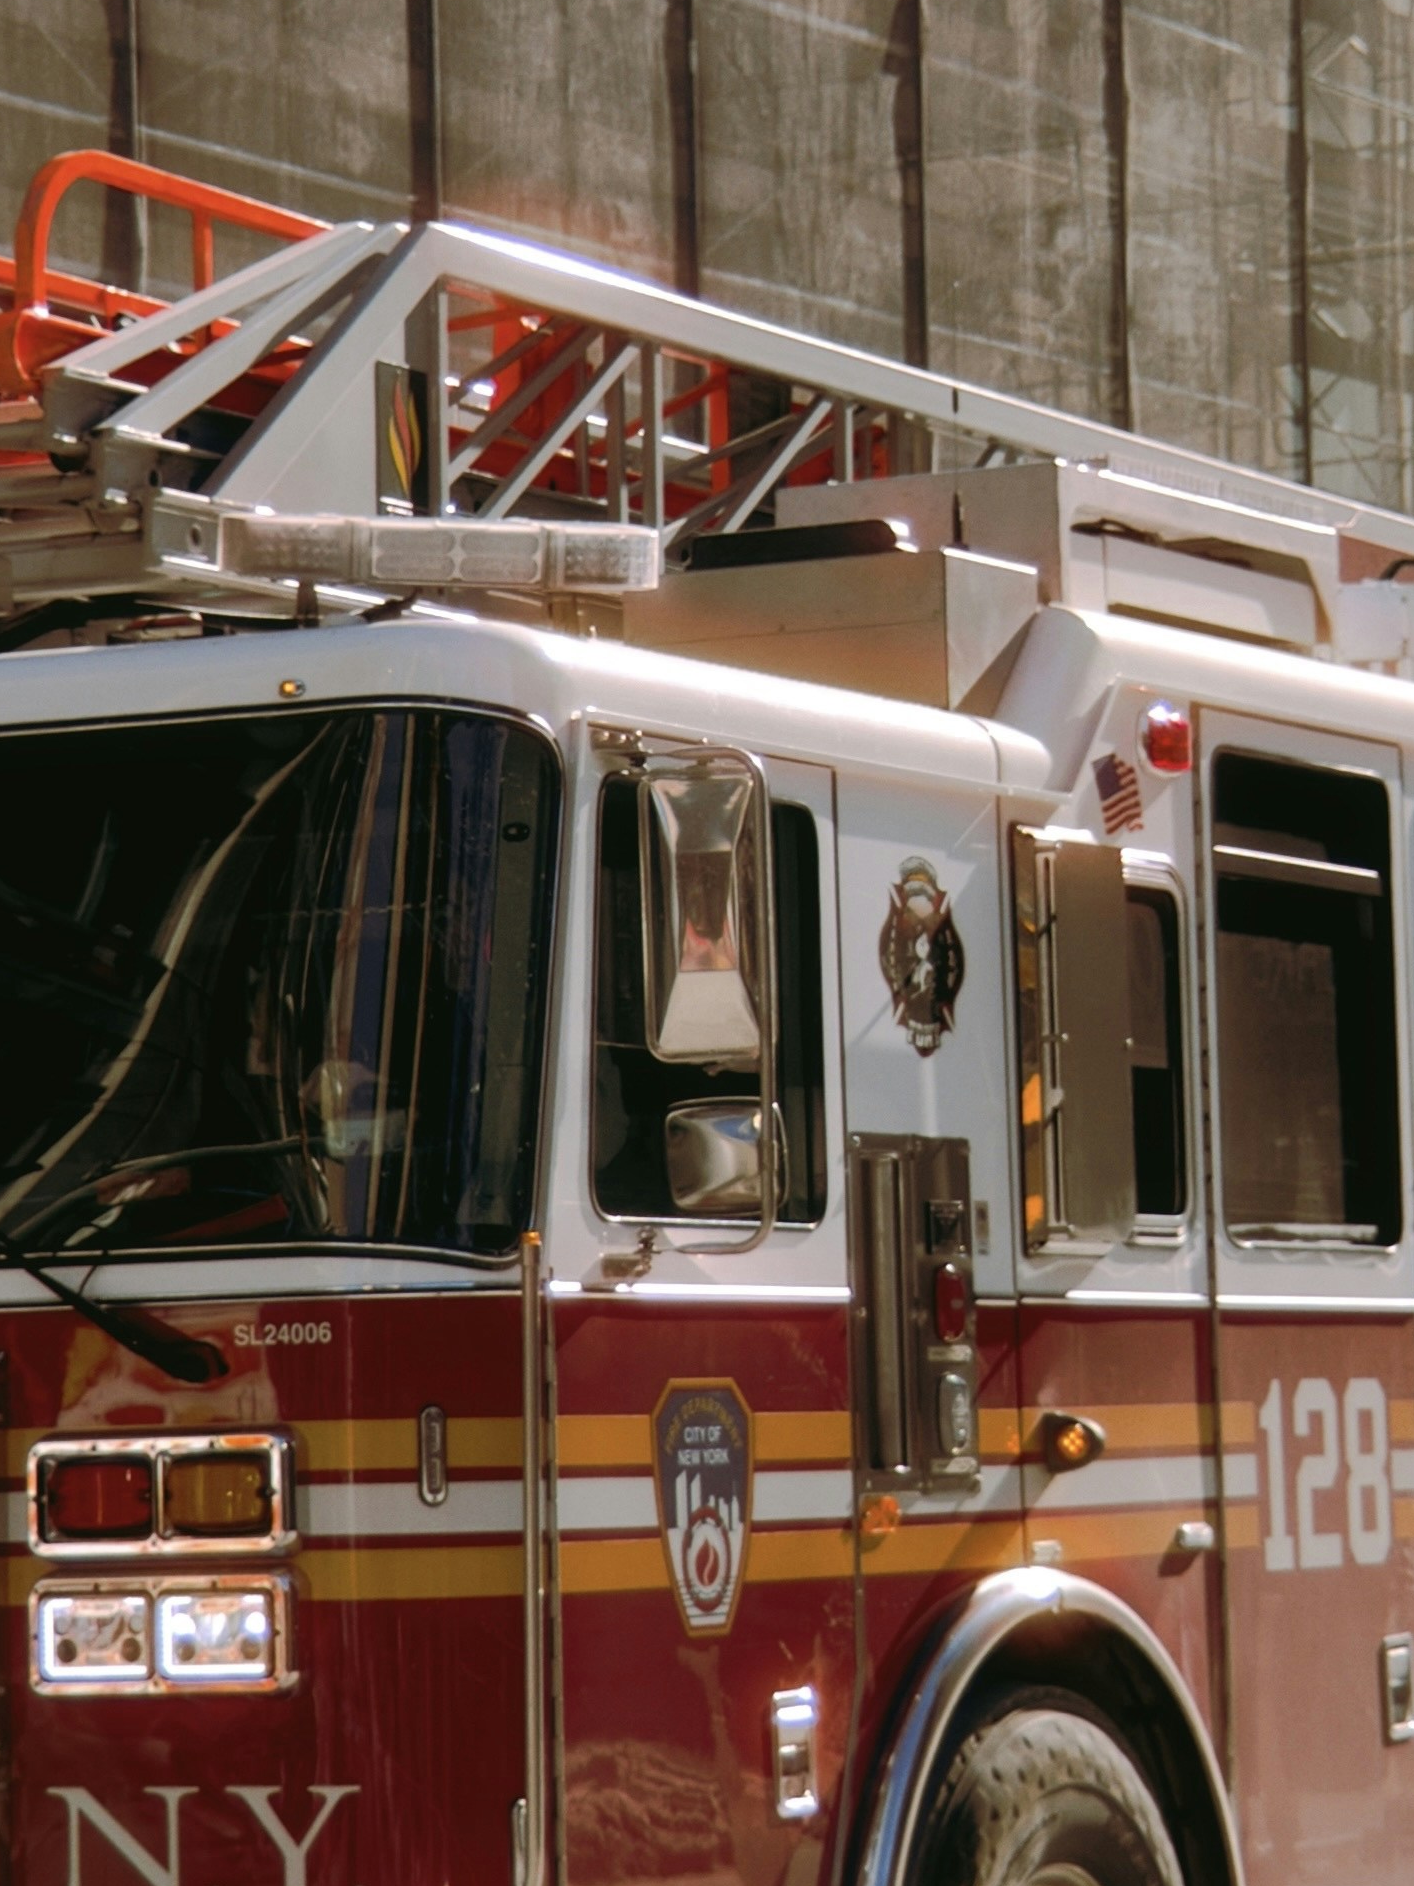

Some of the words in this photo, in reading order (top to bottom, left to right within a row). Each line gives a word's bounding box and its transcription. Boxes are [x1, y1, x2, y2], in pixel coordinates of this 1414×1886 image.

[233, 1321, 333, 1347] SL24006
[684, 1426, 706, 1444] CITY
[707, 1425, 722, 1443] OF
[677, 1448, 701, 1466] NEW
[702, 1447, 730, 1466] YORK
[1258, 1376, 1389, 1573] 128
